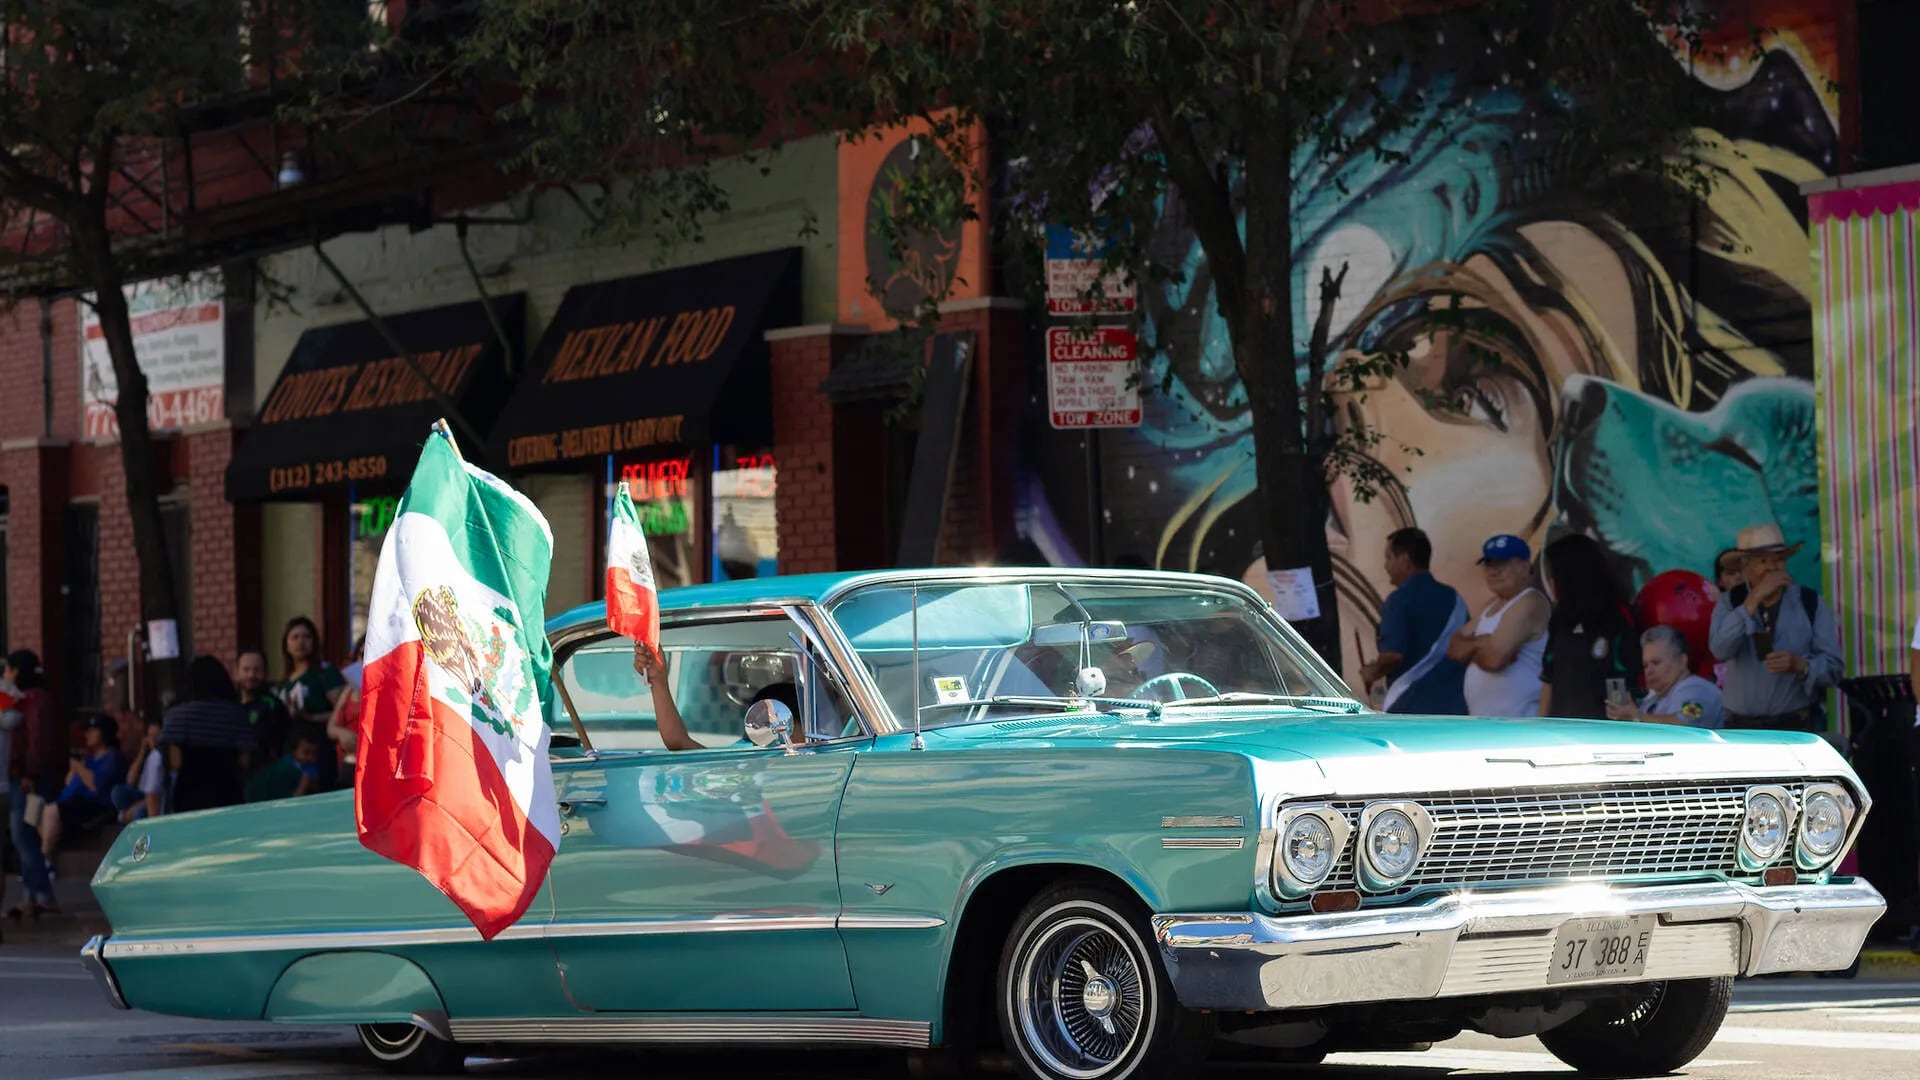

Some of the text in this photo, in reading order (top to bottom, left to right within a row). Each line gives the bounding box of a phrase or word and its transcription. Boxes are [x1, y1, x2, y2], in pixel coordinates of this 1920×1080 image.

[541, 305, 736, 385] MEXICAN FOOD
[1073, 364, 1113, 373] PARKING
[1057, 410, 1133, 425] TOW ZONE
[269, 455, 388, 494] (312) 243-8550
[1586, 920, 1631, 933] ILLINOIS
[1562, 935, 1632, 970] 37 388
